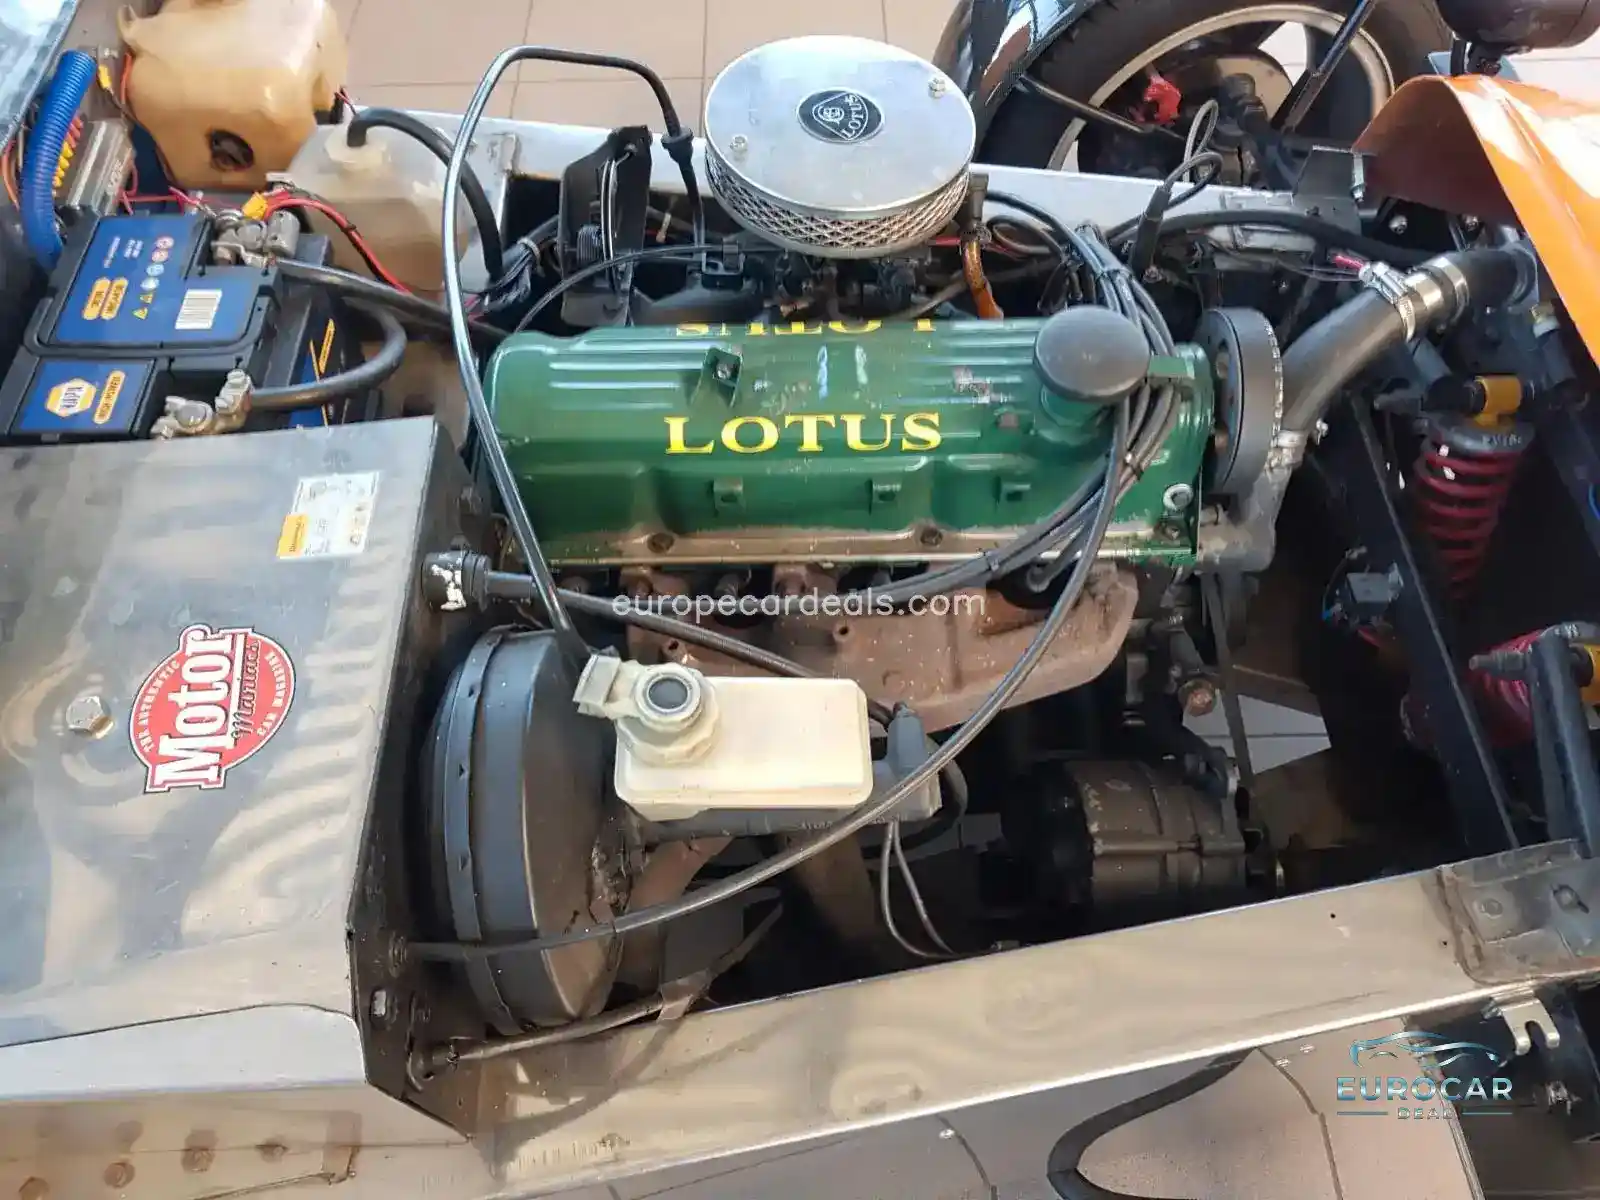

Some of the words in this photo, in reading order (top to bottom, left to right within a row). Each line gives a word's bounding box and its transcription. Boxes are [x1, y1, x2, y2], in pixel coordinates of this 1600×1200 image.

[841, 94, 864, 138] LOTUS
[663, 412, 941, 454] LOTUS
[137, 658, 181, 726] AUTHENTIC
[231, 640, 260, 739] Maniacs
[264, 651, 287, 708] MAGAZINE
[153, 629, 235, 785] Motor
[256, 712, 277, 737] CAR
[138, 729, 155, 753] THE
